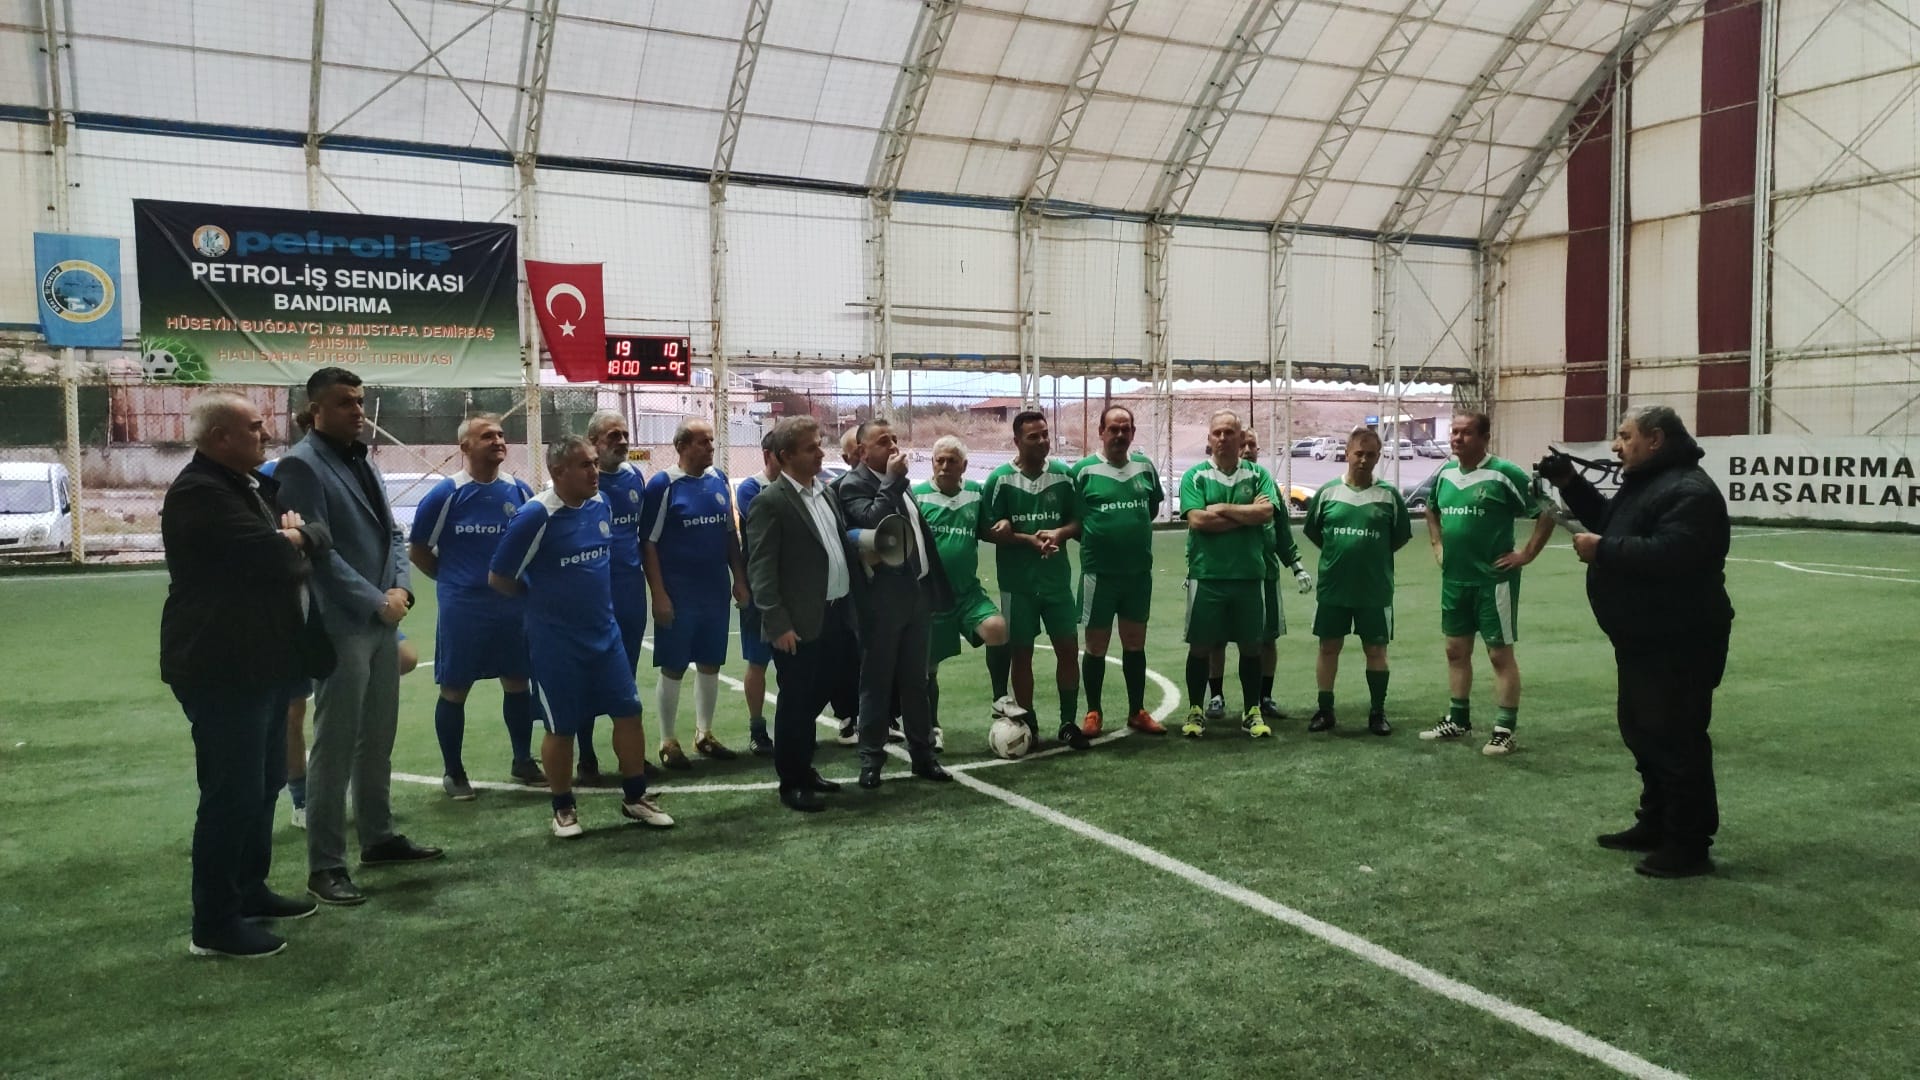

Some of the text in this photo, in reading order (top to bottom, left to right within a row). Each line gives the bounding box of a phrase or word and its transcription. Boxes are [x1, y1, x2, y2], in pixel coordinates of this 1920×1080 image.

[236, 230, 452, 266] petrol-iş
[191, 262, 464, 293] PETROL-İŞ SENDİKASI
[274, 293, 392, 314] BANDIRMA
[166, 314, 496, 341] HÜSEYİN BUĞDAYCI ve MUSTAFA DEMİRBAŞ
[308, 336, 370, 351] ANISINA
[615, 340, 679, 358] 19 10
[218, 350, 454, 367] HALI SAHA FUTBOL TURNUVASI
[1728, 455, 1915, 480] BANDIRMA
[1728, 482, 1920, 508] BAŞARILAR
[682, 513, 728, 528] petrol-i
[1011, 511, 1061, 524] petrol-iş
[455, 524, 506, 535] petrol-
